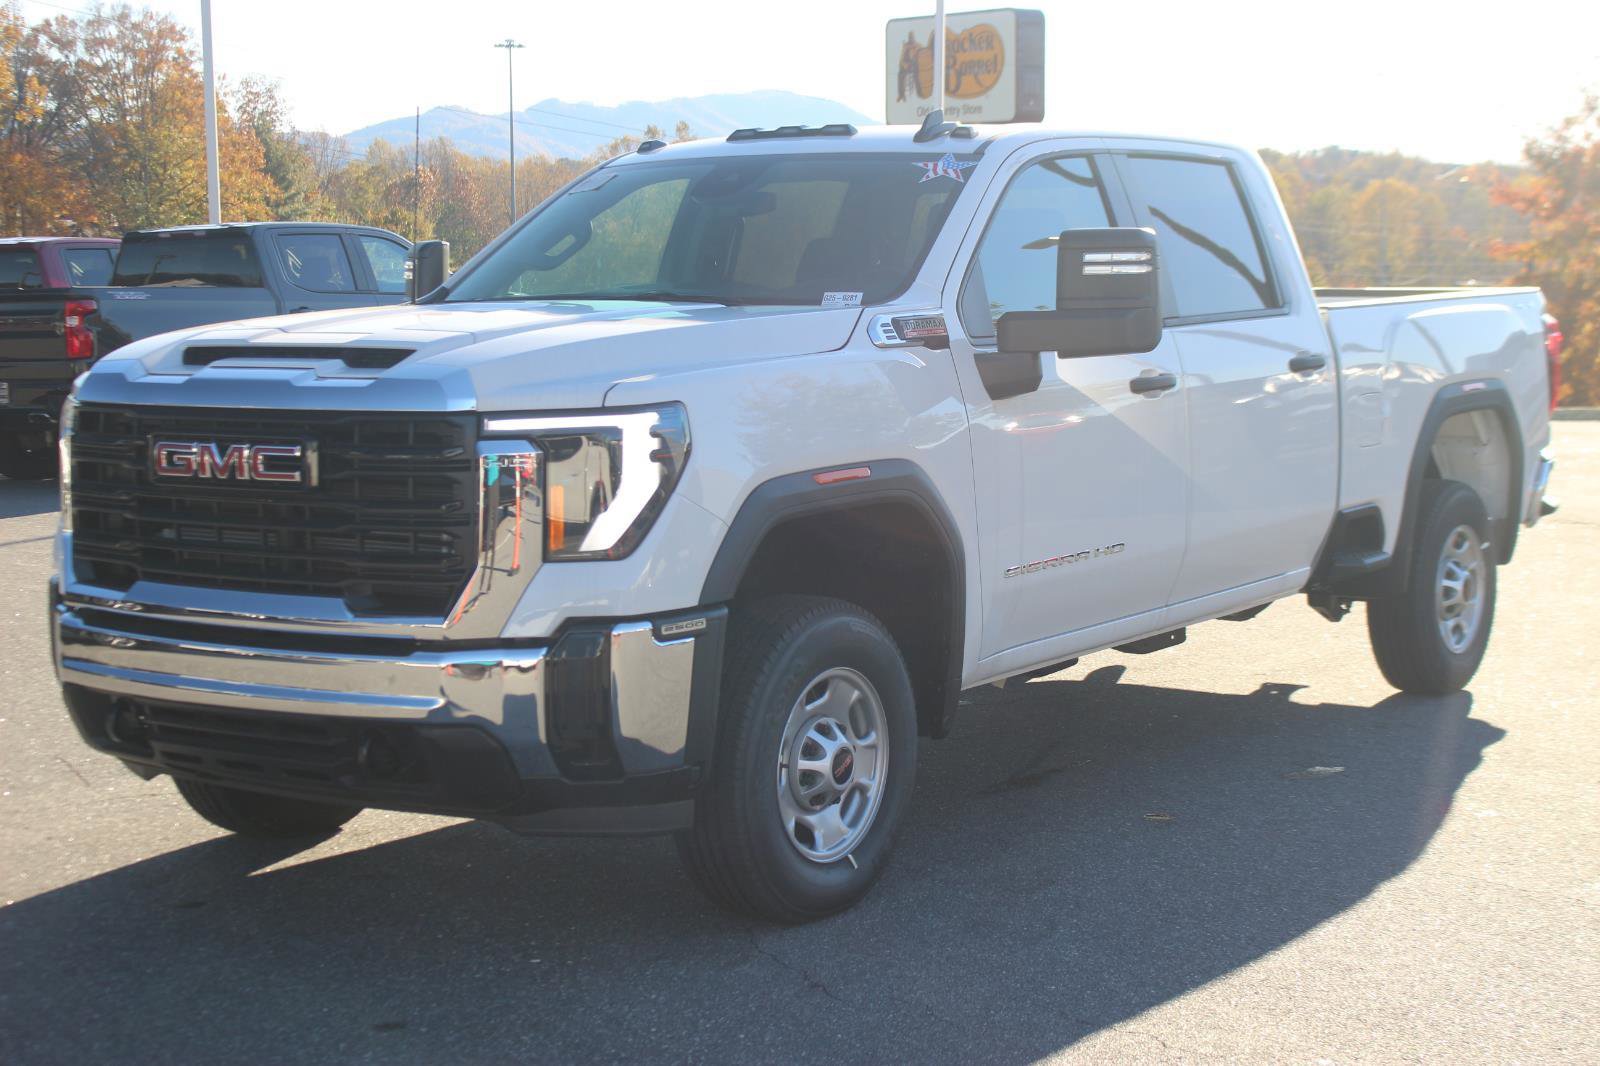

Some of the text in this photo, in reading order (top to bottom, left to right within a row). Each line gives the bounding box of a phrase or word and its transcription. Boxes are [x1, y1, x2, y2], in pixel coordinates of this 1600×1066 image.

[904, 319, 944, 331] DURAMAX
[154, 441, 301, 482] GMC
[1003, 542, 1125, 578] SIERRA HD
[663, 620, 704, 632] 2500
